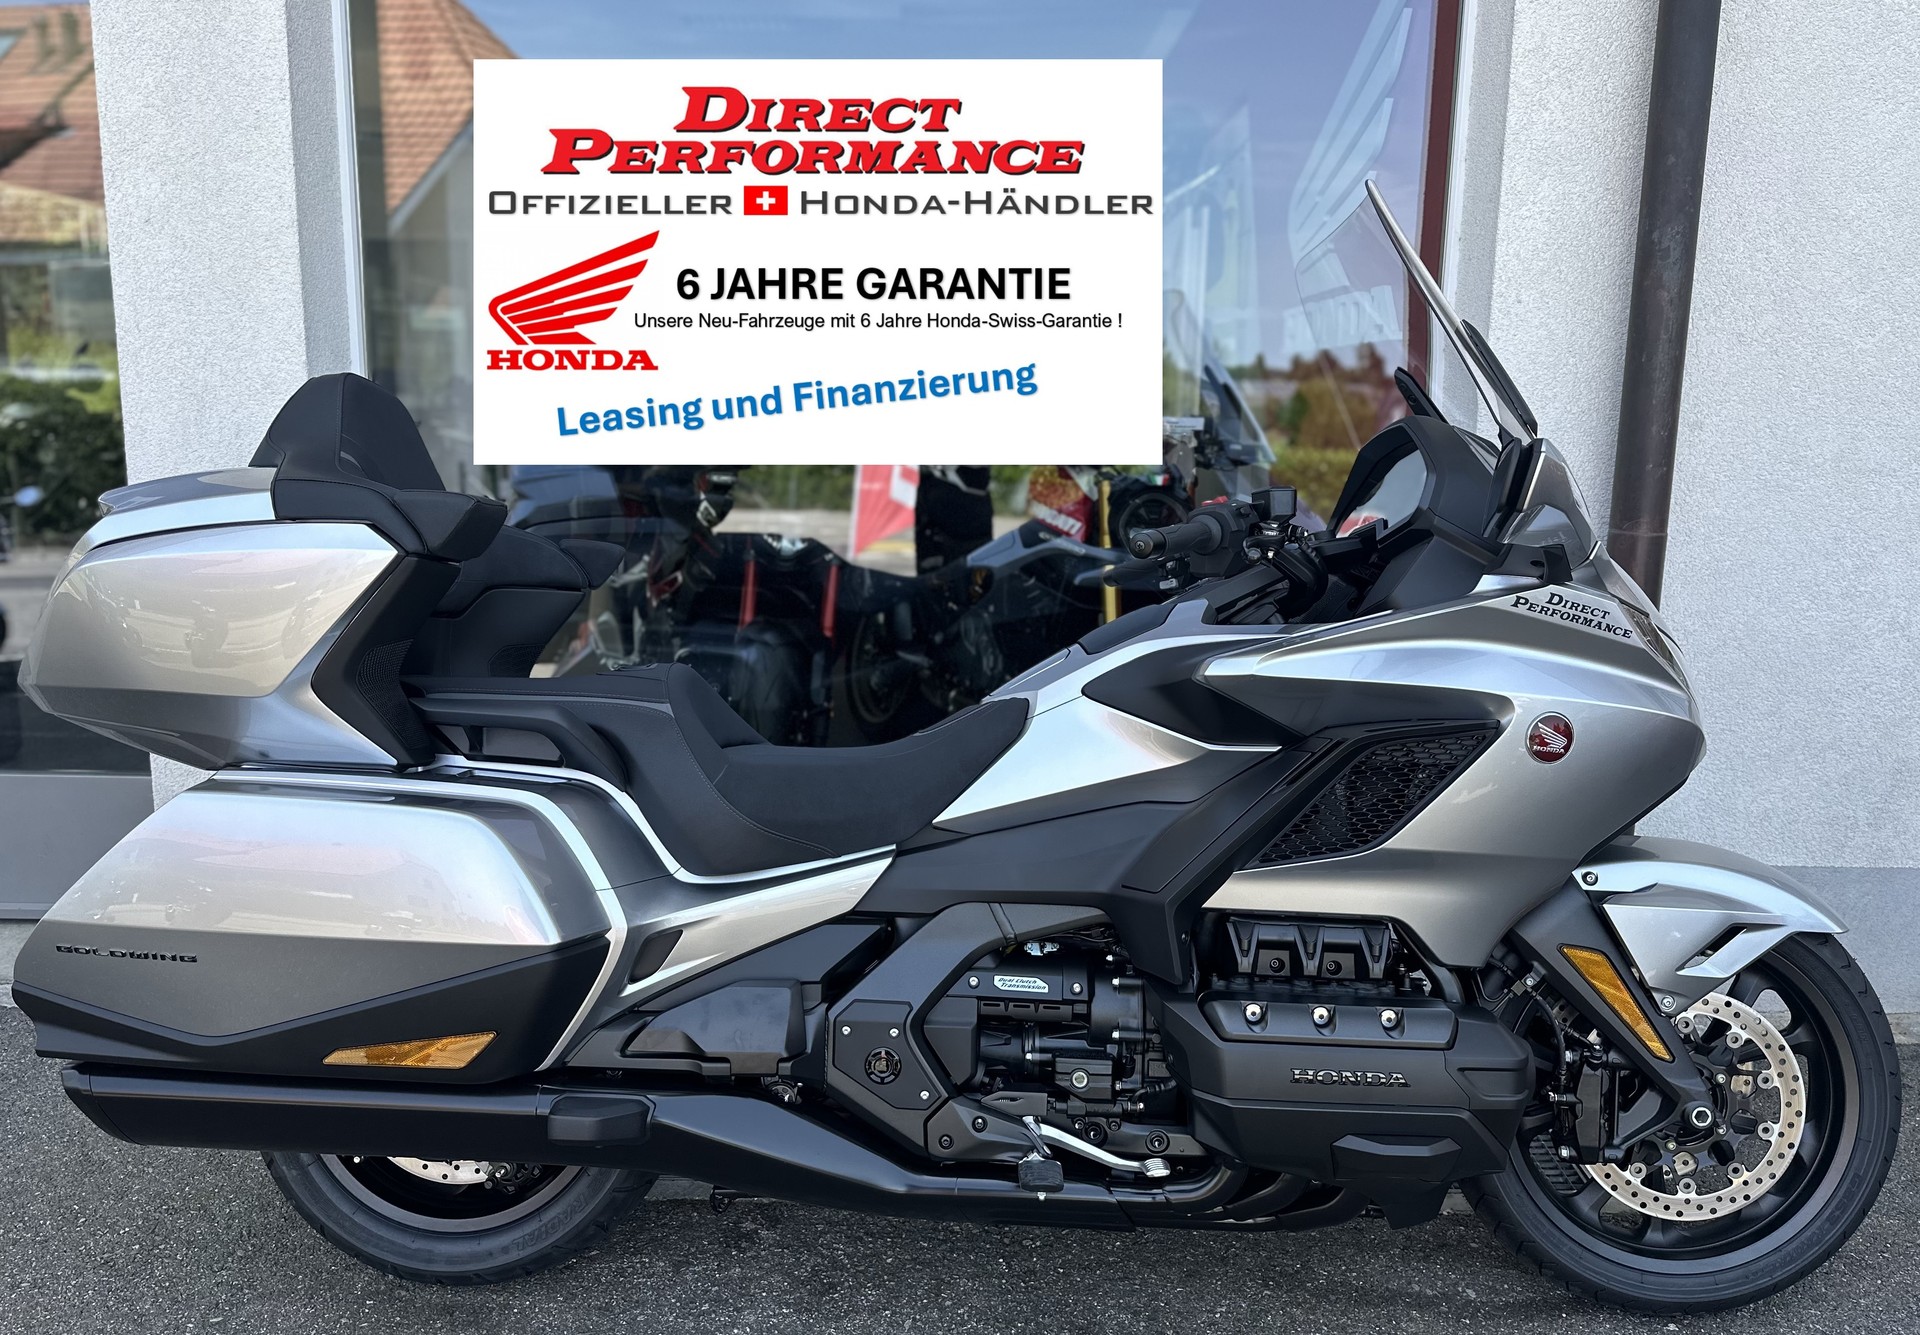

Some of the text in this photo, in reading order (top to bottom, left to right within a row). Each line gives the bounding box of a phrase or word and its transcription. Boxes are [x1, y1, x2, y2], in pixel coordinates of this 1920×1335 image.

[1545, 592, 1611, 619] DIRECT
[1510, 595, 1633, 639] PERFORMANCE
[1532, 745, 1565, 754] HONDA
[55, 944, 198, 963] GOLDWING
[1000, 982, 1047, 990] Transmission
[1290, 1068, 1411, 1088] HONDA
